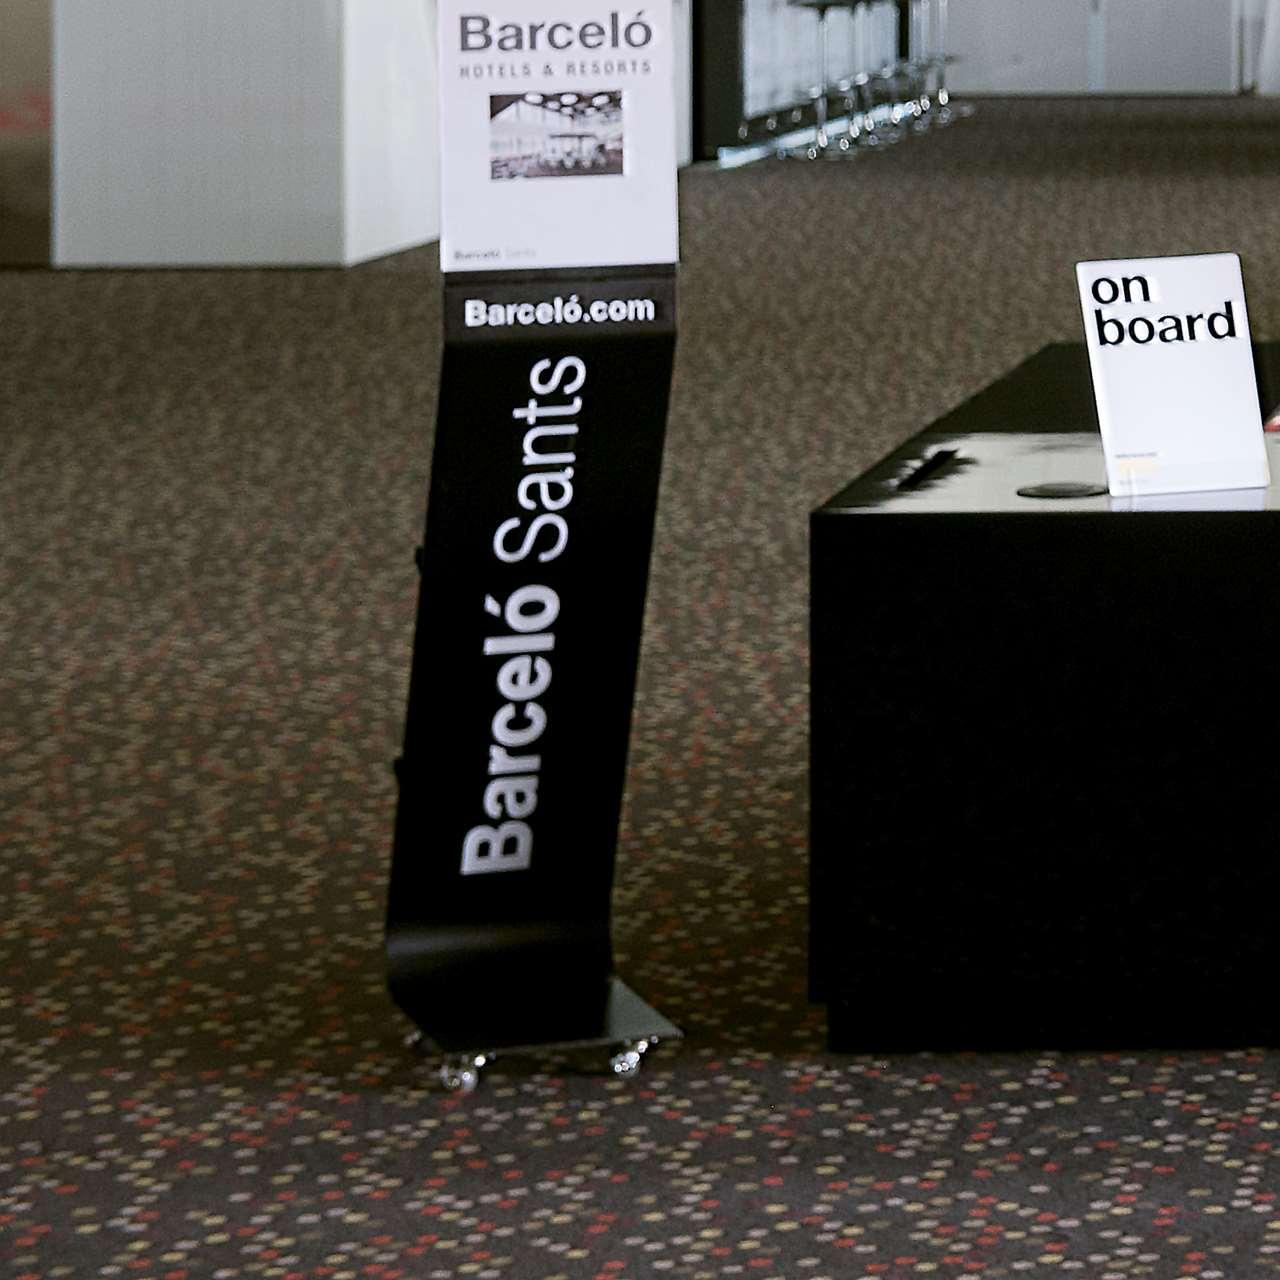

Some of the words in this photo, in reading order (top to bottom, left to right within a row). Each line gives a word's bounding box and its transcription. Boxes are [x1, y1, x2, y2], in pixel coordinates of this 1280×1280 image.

[459, 10, 653, 52] Barceló
[459, 63, 532, 80] HOTELS
[542, 63, 554, 77] &
[565, 60, 652, 76] RESORTS
[464, 294, 655, 327] Barceló.com
[1091, 275, 1151, 305] on
[1097, 301, 1237, 346] board
[493, 356, 587, 562] Sants
[460, 584, 560, 875] Barceló
